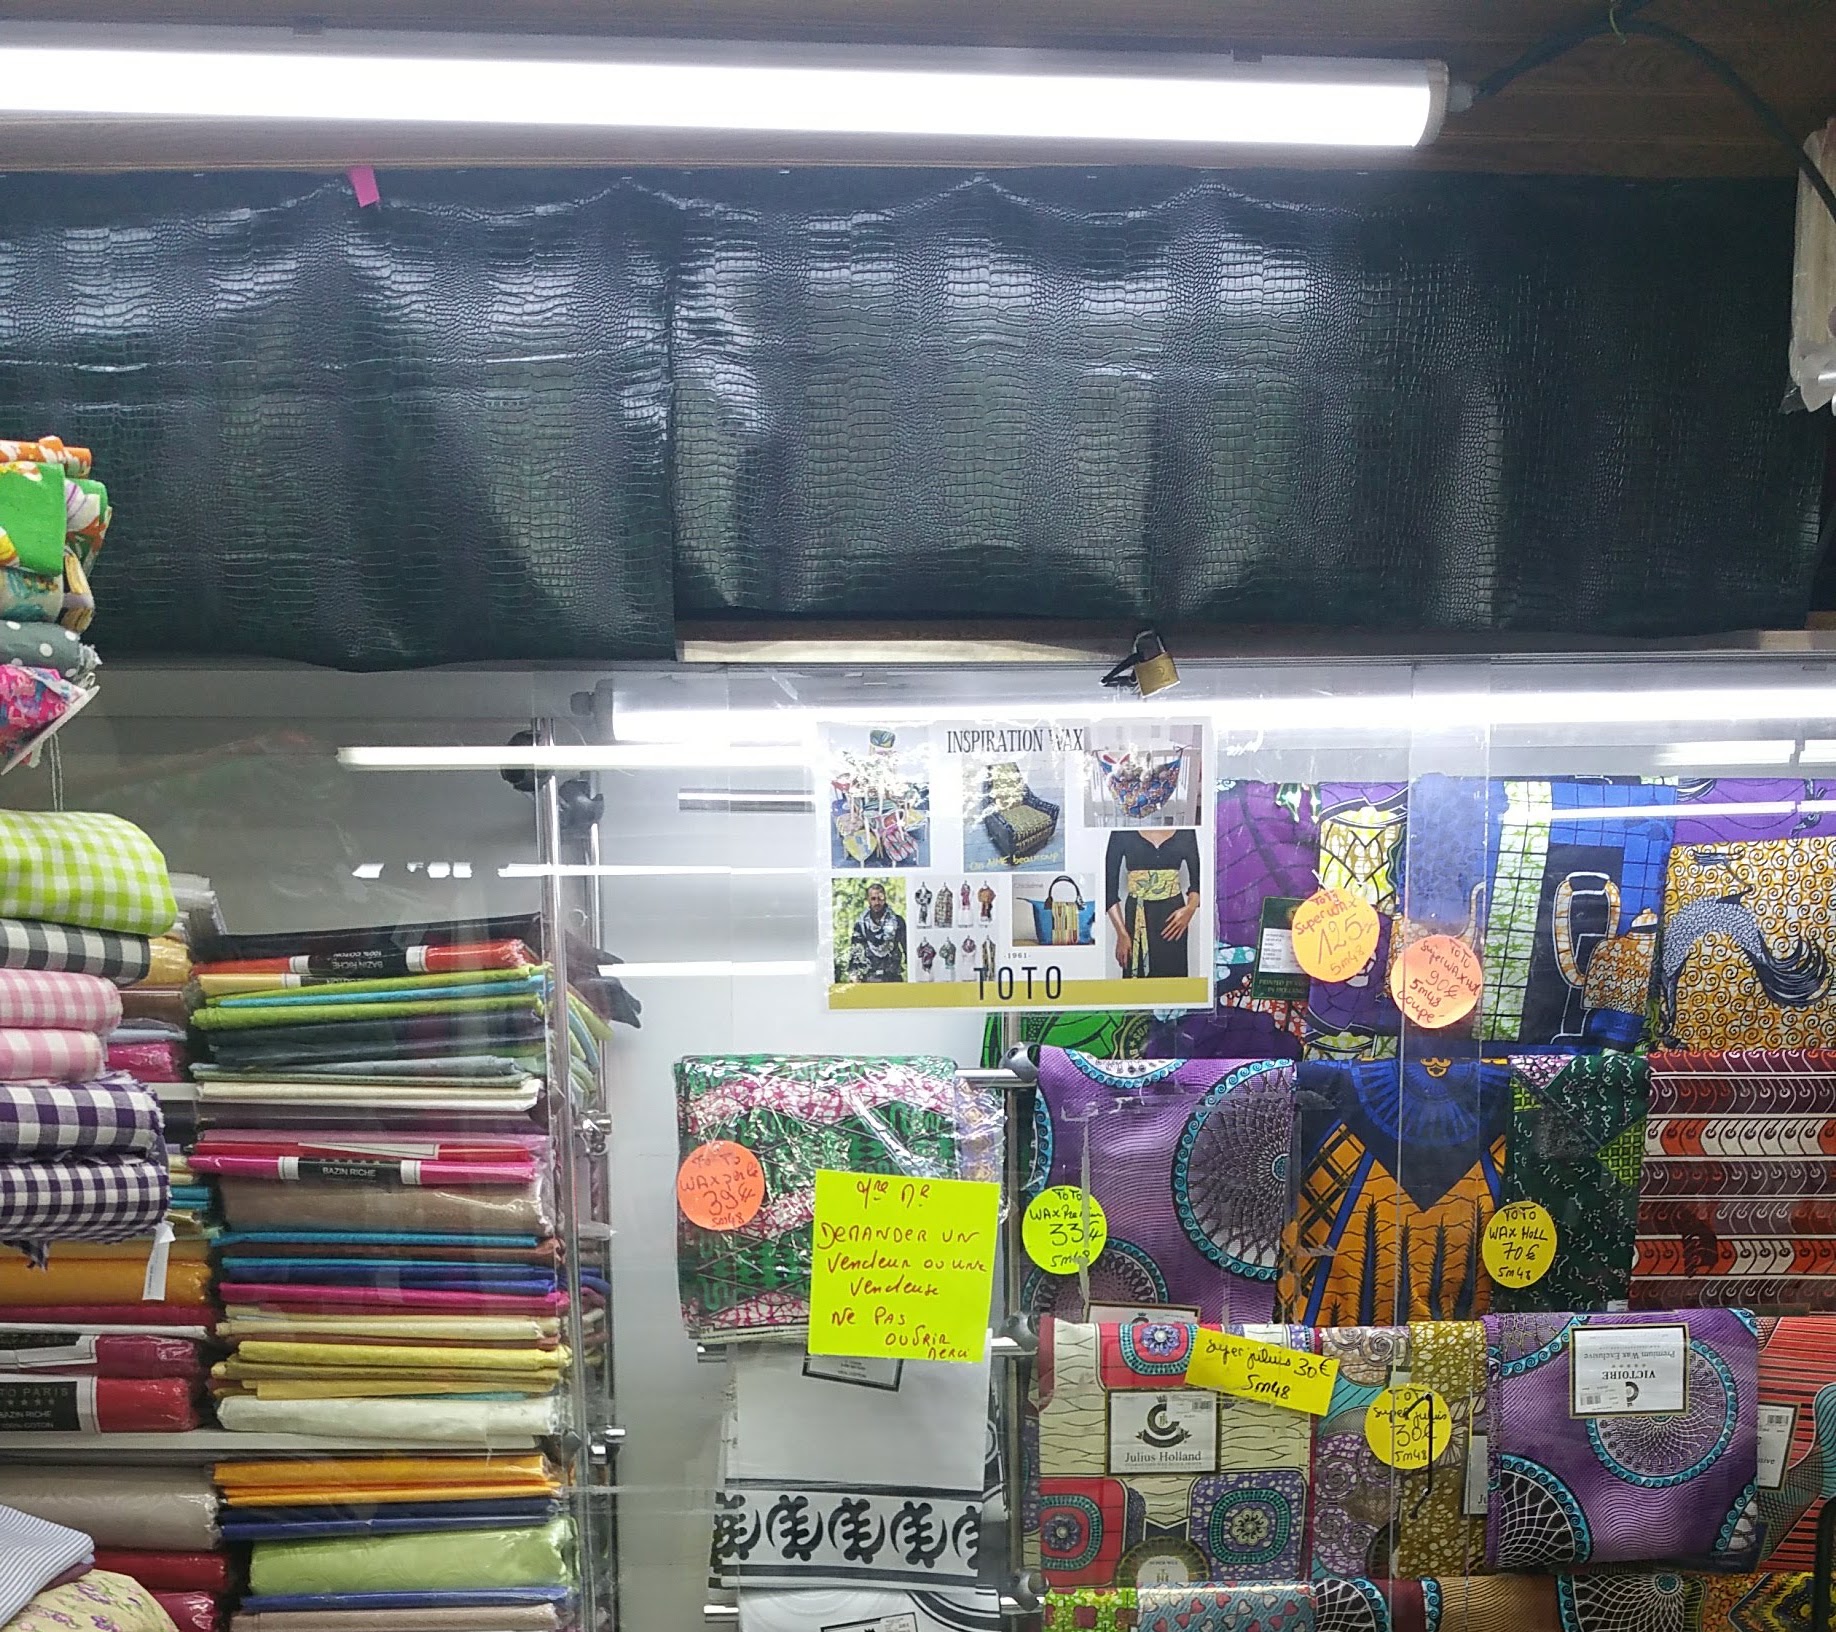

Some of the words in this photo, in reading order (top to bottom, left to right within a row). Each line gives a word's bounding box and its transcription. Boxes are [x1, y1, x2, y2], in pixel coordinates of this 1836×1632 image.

[947, 729, 1043, 753] INSPIRATION
[1049, 728, 1084, 751] WAX
[974, 965, 1062, 1000] TOTO
[322, 1166, 348, 1175] BAZIN
[350, 1168, 376, 1177] RICHE
[680, 1175, 720, 1192] WAX
[1051, 1188, 1083, 1201] TOTO
[1029, 1207, 1060, 1221] WAX
[1503, 1205, 1537, 1222] TOTO
[1489, 1225, 1518, 1241] WAX
[1502, 1241, 1540, 1261] 70€
[1498, 1266, 1531, 1281] 5m48
[874, 1306, 906, 1326] PAS
[1583, 1352, 1620, 1361] Exclusive
[1621, 1351, 1640, 1360] Wax
[1641, 1350, 1676, 1358] Premium
[1601, 1370, 1656, 1380] VICTOIRE
[22, 1387, 68, 1397] PARIS
[1240, 1374, 1292, 1400] 5m48
[25, 1410, 52, 1418] RICHE
[1125, 1451, 1156, 1463] Julius
[1159, 1450, 1202, 1462] Holland
